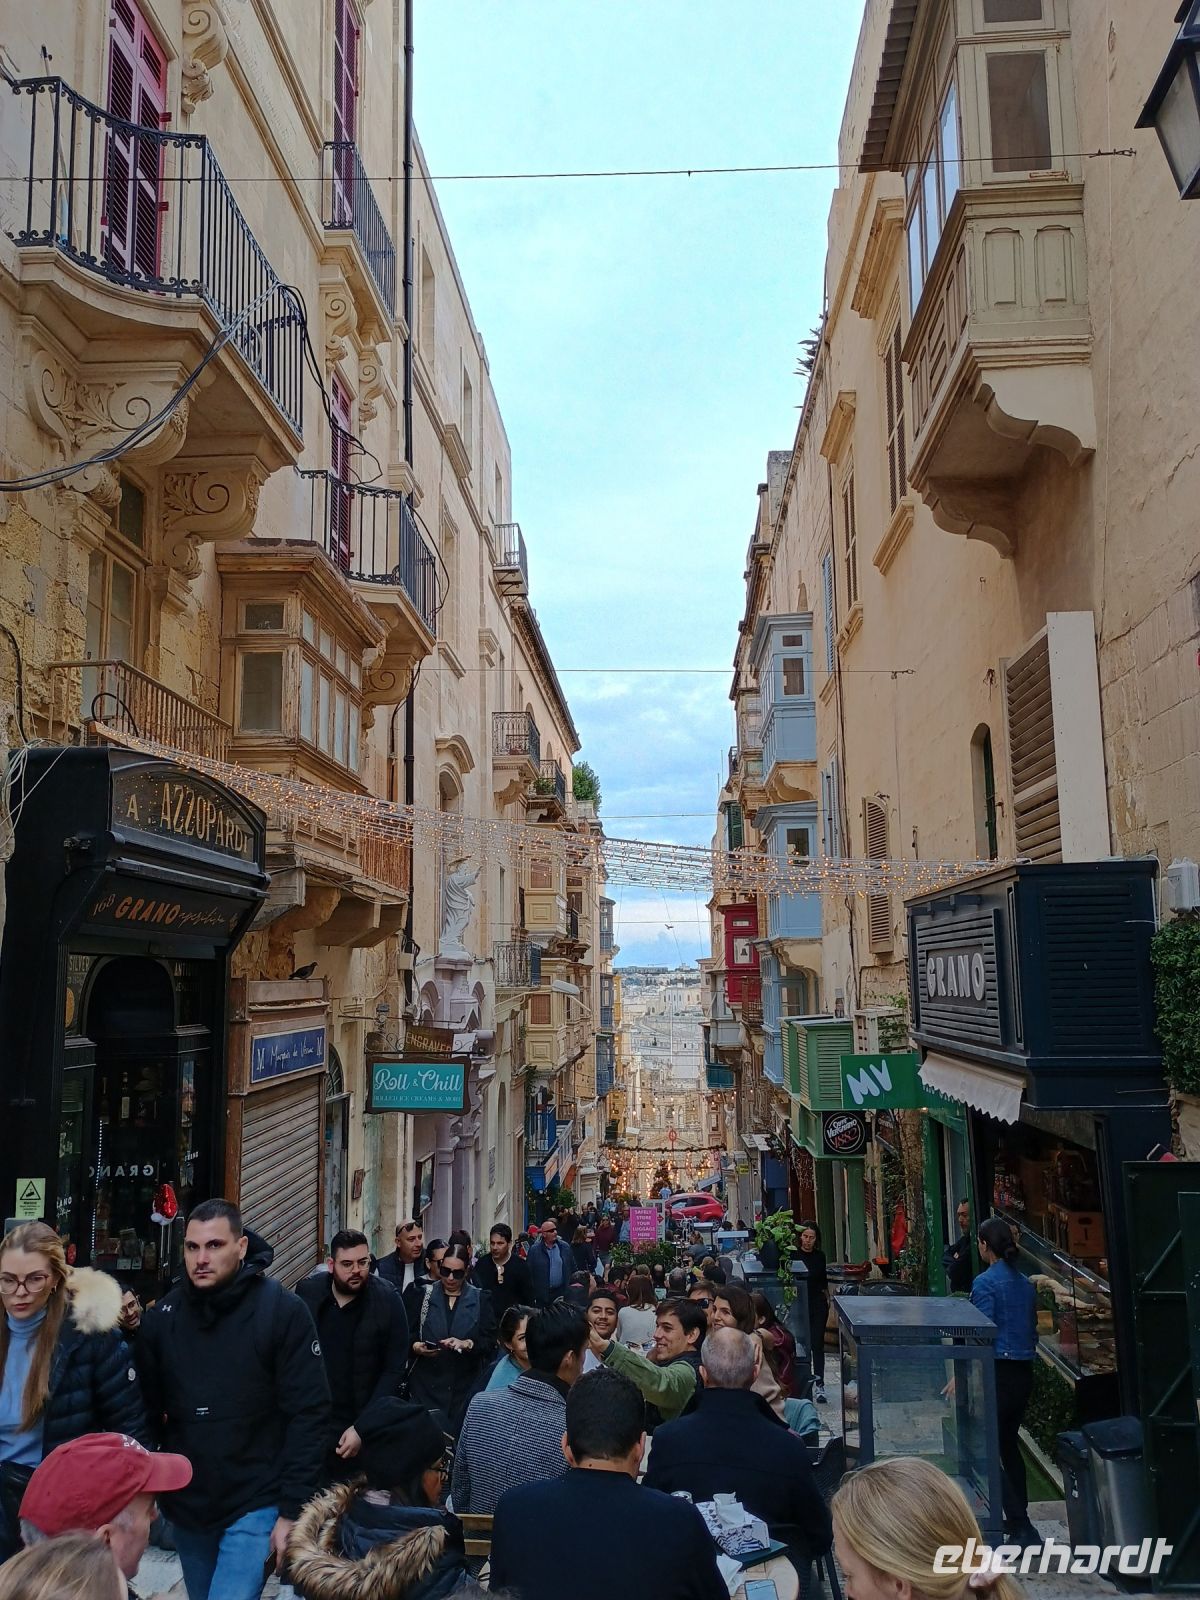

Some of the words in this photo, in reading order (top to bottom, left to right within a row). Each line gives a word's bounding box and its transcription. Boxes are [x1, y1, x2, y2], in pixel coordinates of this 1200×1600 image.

[159, 782, 248, 853] AZZOPARDI
[114, 896, 182, 925] GRANO
[926, 952, 985, 1001] GRANO
[374, 1068, 410, 1090] Roll
[412, 1078, 419, 1087] &
[417, 1069, 463, 1091] Chill
